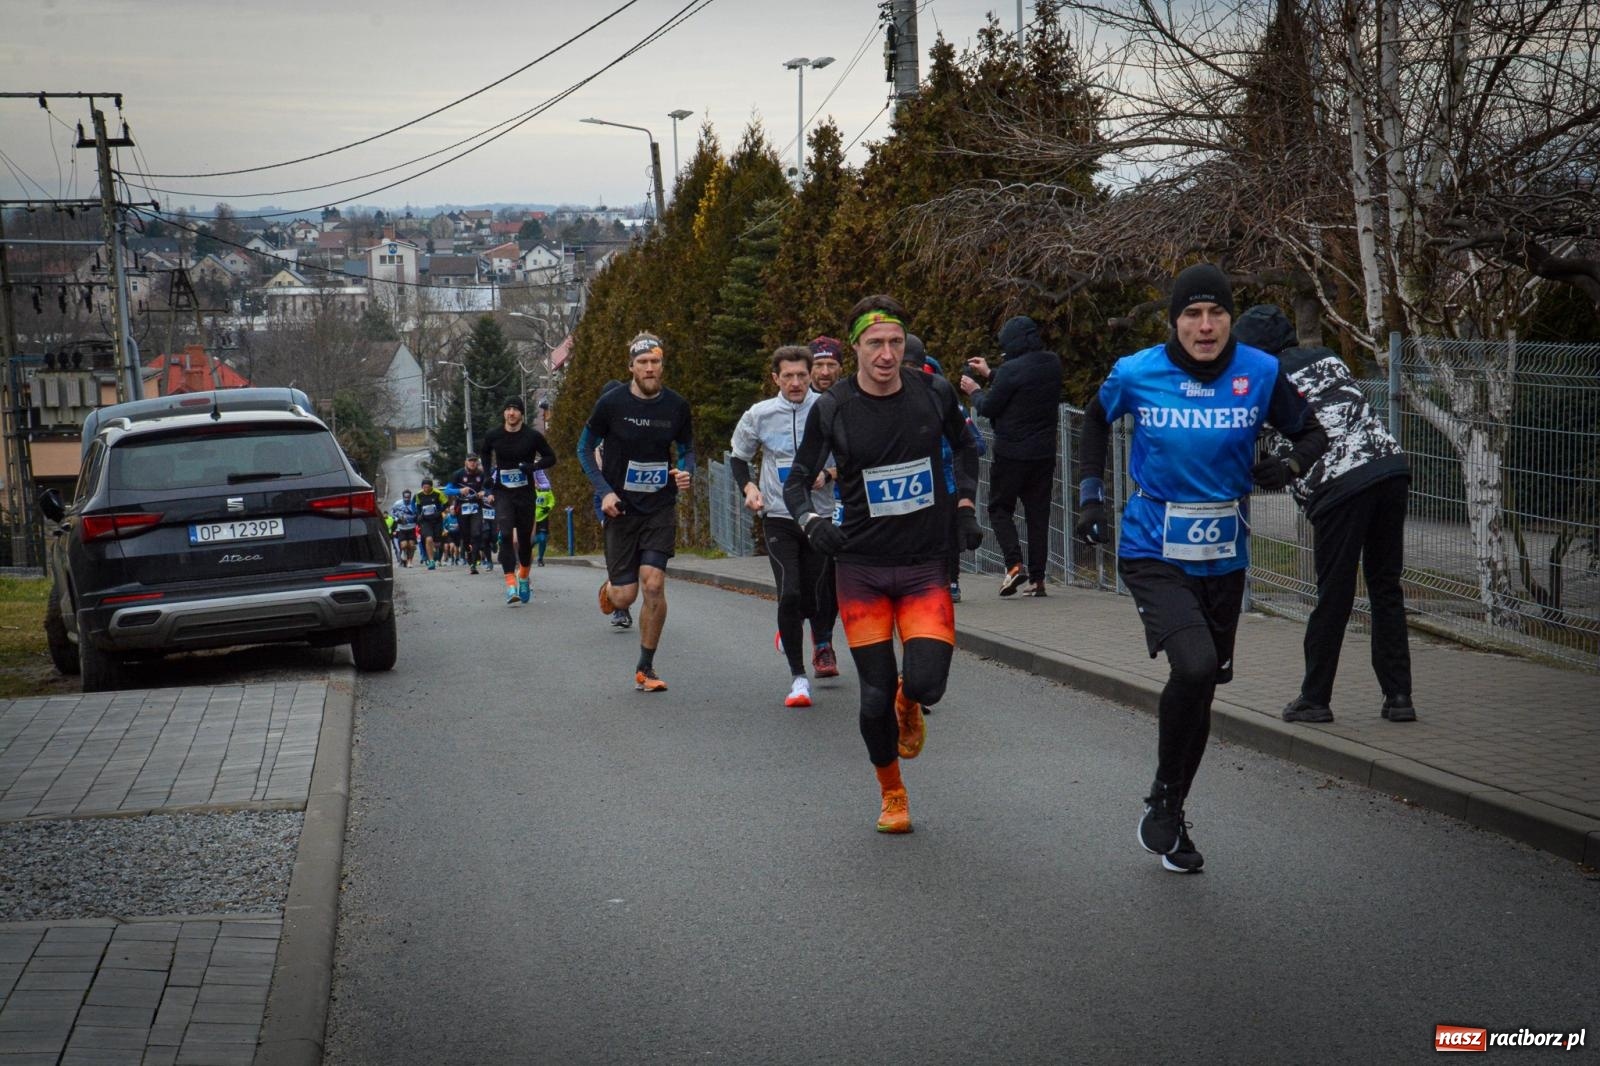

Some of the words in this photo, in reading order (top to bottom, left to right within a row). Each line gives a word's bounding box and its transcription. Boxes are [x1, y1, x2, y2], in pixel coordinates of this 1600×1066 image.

[1137, 406, 1259, 428] RUNNERS
[634, 470, 661, 484] 126
[879, 474, 923, 501] 176
[200, 525, 222, 541] OP
[229, 520, 279, 538] 1239P
[1187, 519, 1221, 543] 66
[218, 554, 264, 564] Ateca
